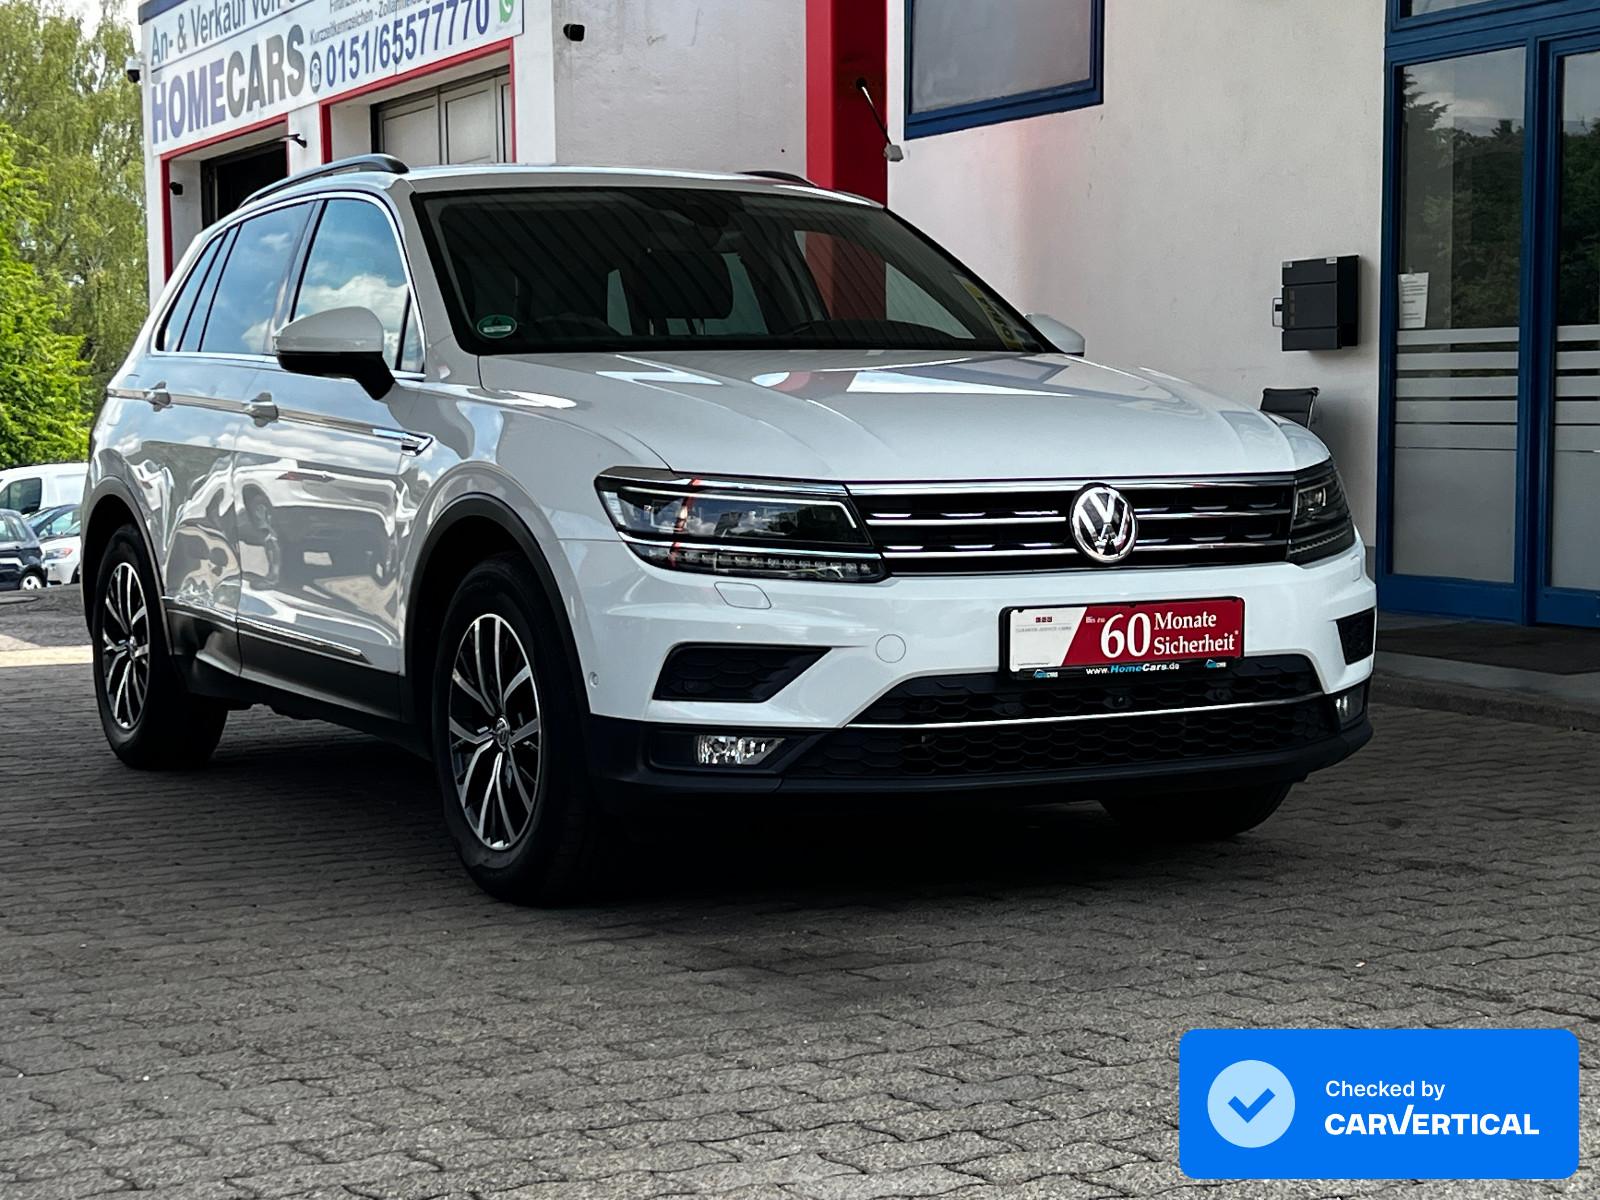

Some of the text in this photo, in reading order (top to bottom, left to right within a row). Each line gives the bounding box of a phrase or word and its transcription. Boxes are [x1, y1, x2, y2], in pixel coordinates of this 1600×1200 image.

[151, 26, 173, 66] An-
[177, 13, 187, 54] &
[191, 0, 247, 47] Verkauf
[326, 0, 490, 88] 0151/65577770
[152, 24, 306, 145] HOMECARS
[1100, 611, 1151, 658] 60
[1153, 612, 1217, 631] Monate
[1085, 662, 1180, 675] www.HomeCars.de
